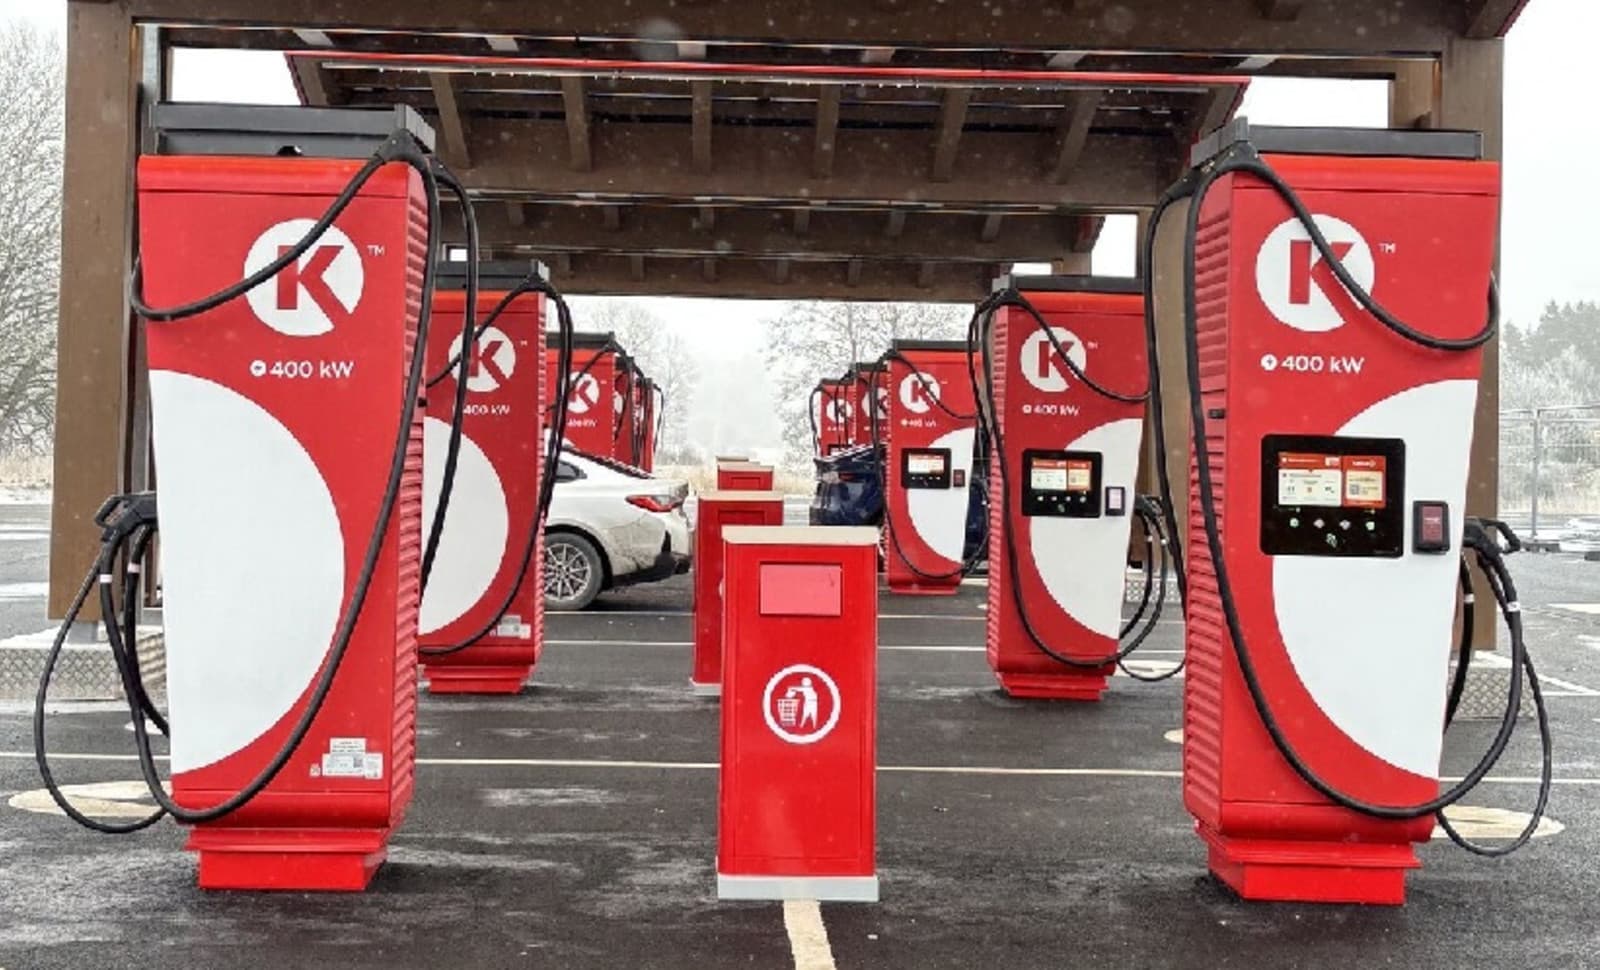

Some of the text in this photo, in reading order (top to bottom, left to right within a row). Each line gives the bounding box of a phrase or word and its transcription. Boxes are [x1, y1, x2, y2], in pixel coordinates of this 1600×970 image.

[276, 245, 350, 328] K
[1289, 239, 1360, 323] K
[269, 361, 354, 379] 400 kW
[469, 340, 508, 389] K
[1038, 341, 1077, 389] K
[1281, 355, 1365, 373] 400 kW
[463, 405, 488, 415] 400
[1033, 405, 1058, 415] 400
